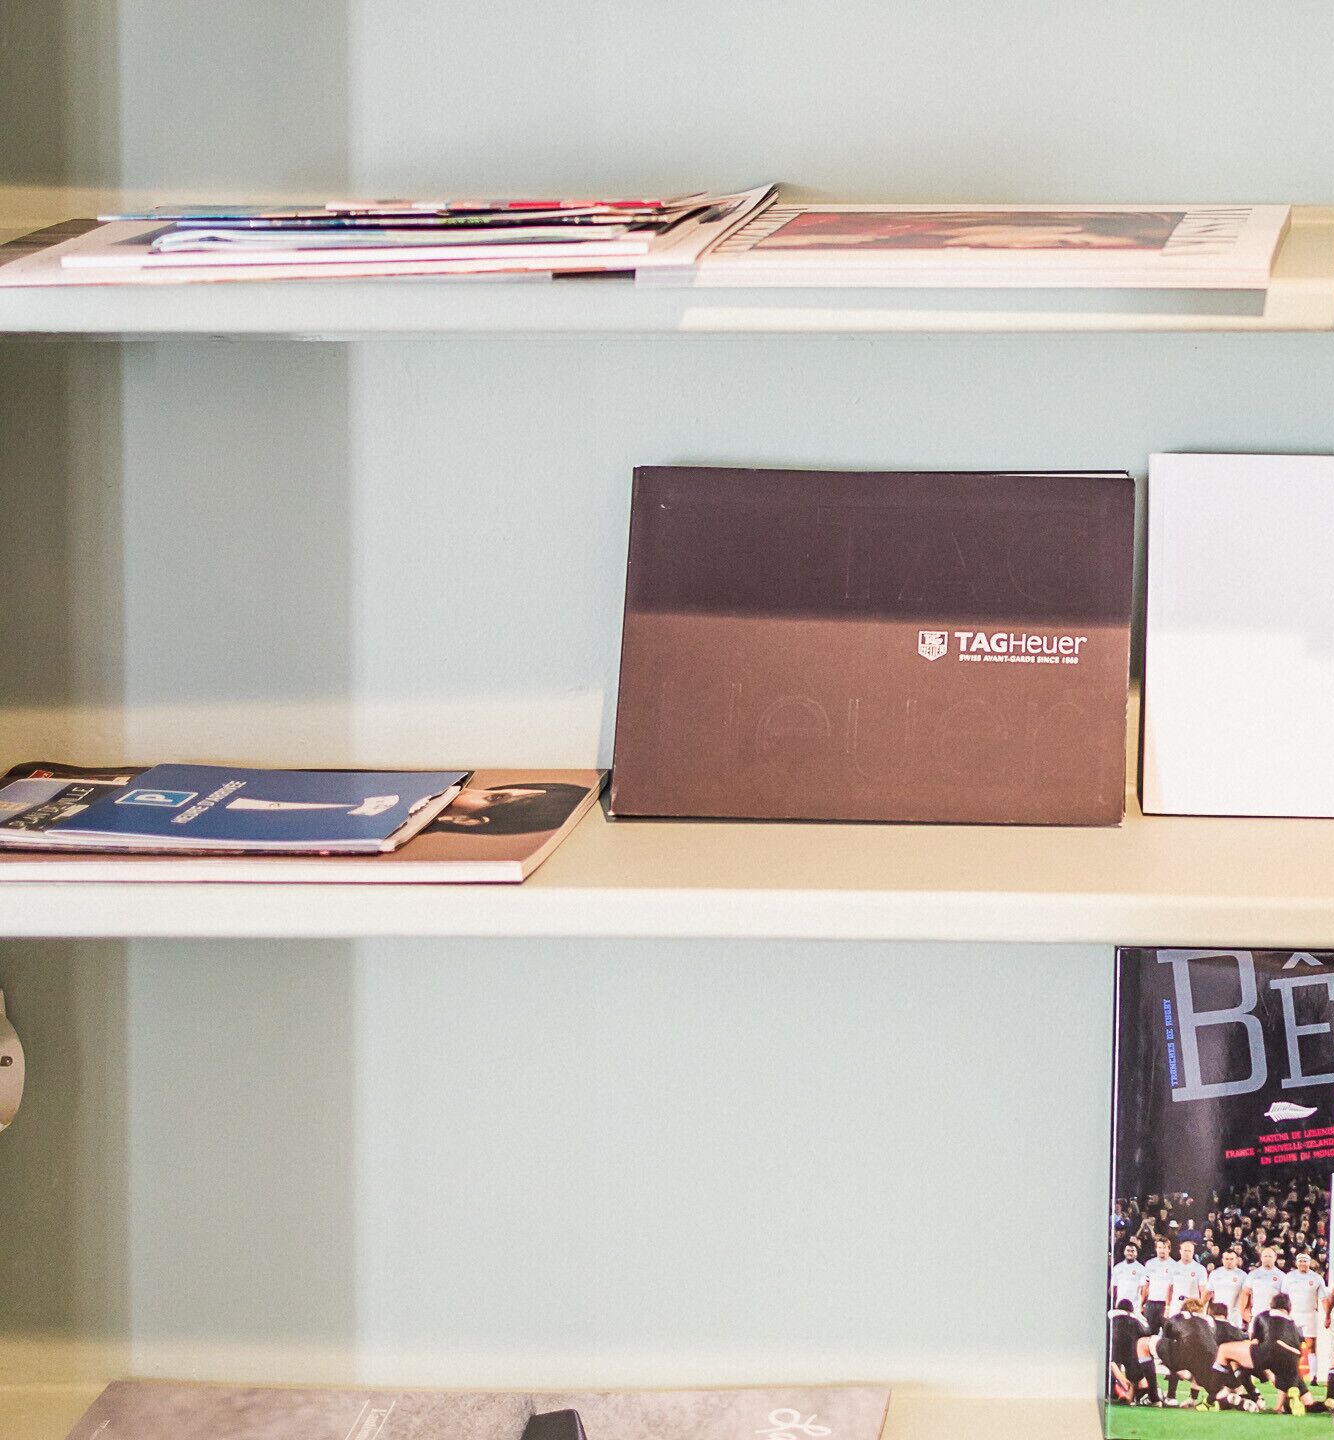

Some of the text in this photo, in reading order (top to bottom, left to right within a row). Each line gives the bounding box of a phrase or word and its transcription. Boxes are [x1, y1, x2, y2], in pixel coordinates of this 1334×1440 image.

[959, 654, 981, 662] SWISS
[983, 654, 1036, 664] AVANT-GARDE
[1037, 655, 1060, 664] SINCE
